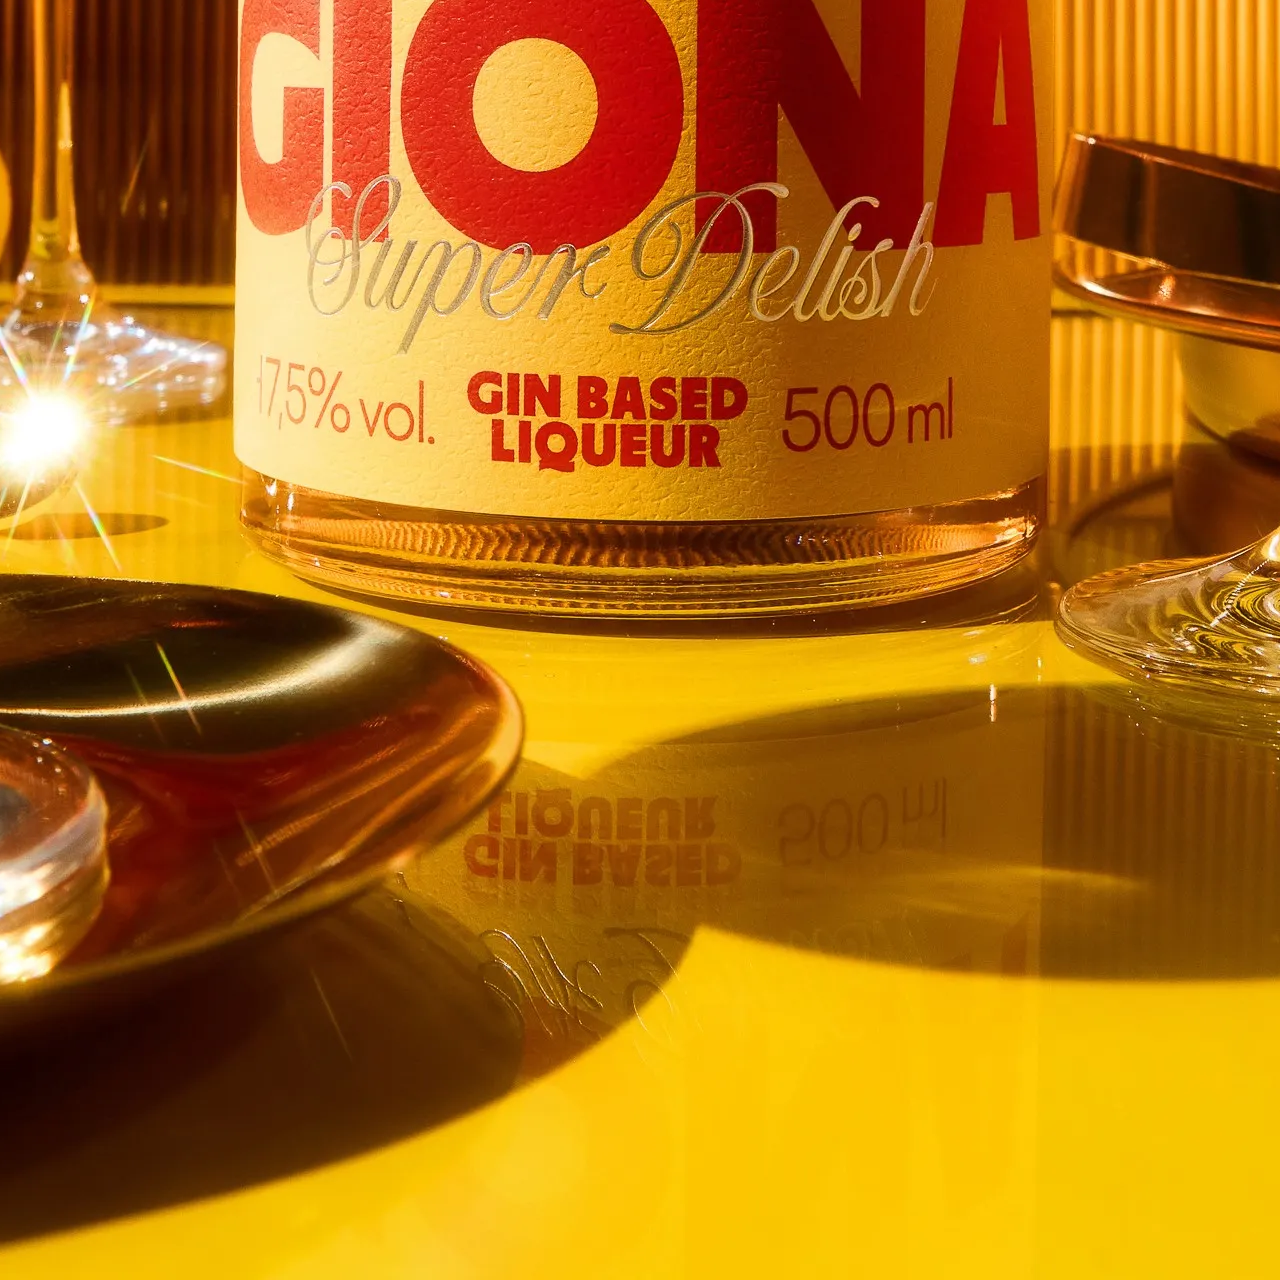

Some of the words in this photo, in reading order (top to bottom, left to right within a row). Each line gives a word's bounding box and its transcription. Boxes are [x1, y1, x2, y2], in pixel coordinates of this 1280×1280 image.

[304, 174, 612, 356] Super
[608, 181, 937, 336] Delish
[256, 354, 351, 434] 17,5%
[359, 379, 436, 445] vol.
[467, 370, 562, 418] GIN
[577, 375, 749, 421] BASED
[782, 381, 896, 453] 500
[907, 376, 954, 445] ml
[491, 419, 722, 473] LIQUEUR
